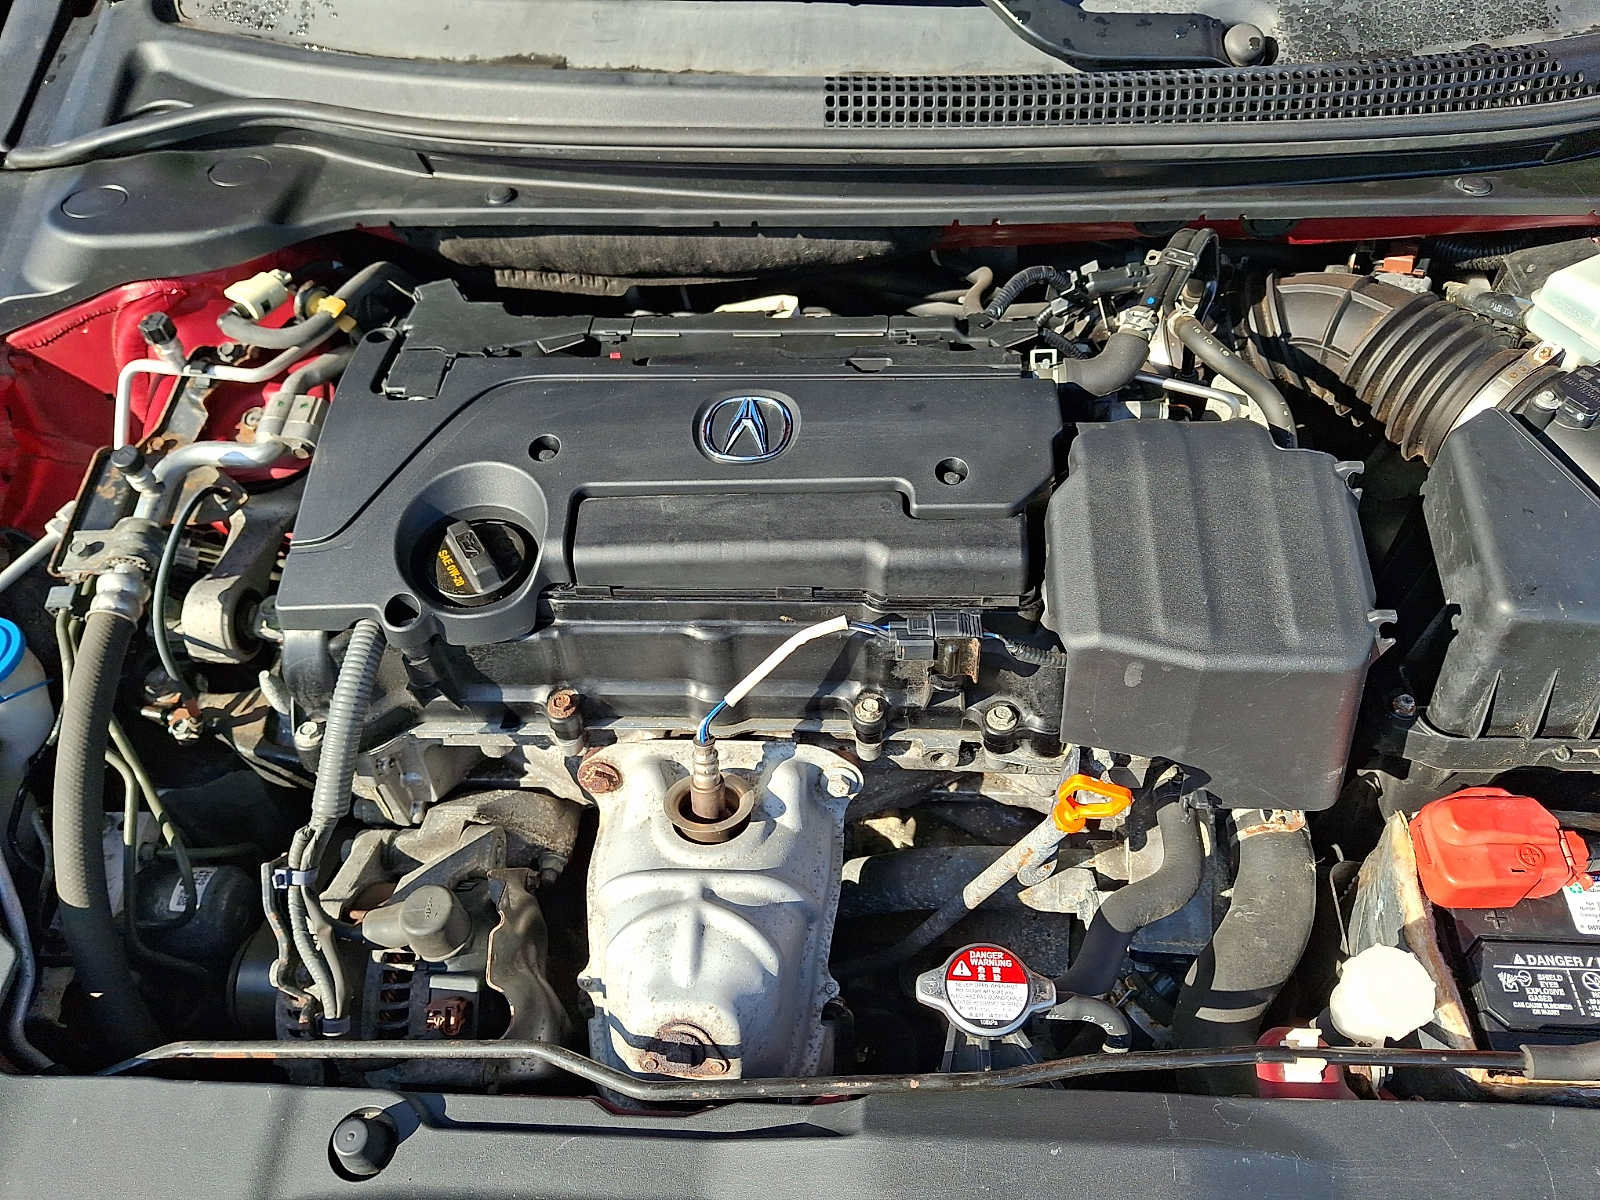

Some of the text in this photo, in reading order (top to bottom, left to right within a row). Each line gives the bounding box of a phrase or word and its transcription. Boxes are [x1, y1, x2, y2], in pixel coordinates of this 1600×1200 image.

[438, 550, 464, 586] SAE 0W-20
[969, 951, 1004, 960] DANGER
[1525, 954, 1584, 967] DANGER
[1536, 973, 1563, 982] SHIELD
[1539, 980, 1559, 988] EYES
[1525, 987, 1566, 996] EXPLOSIVE
[1528, 994, 1554, 1003] GASES
